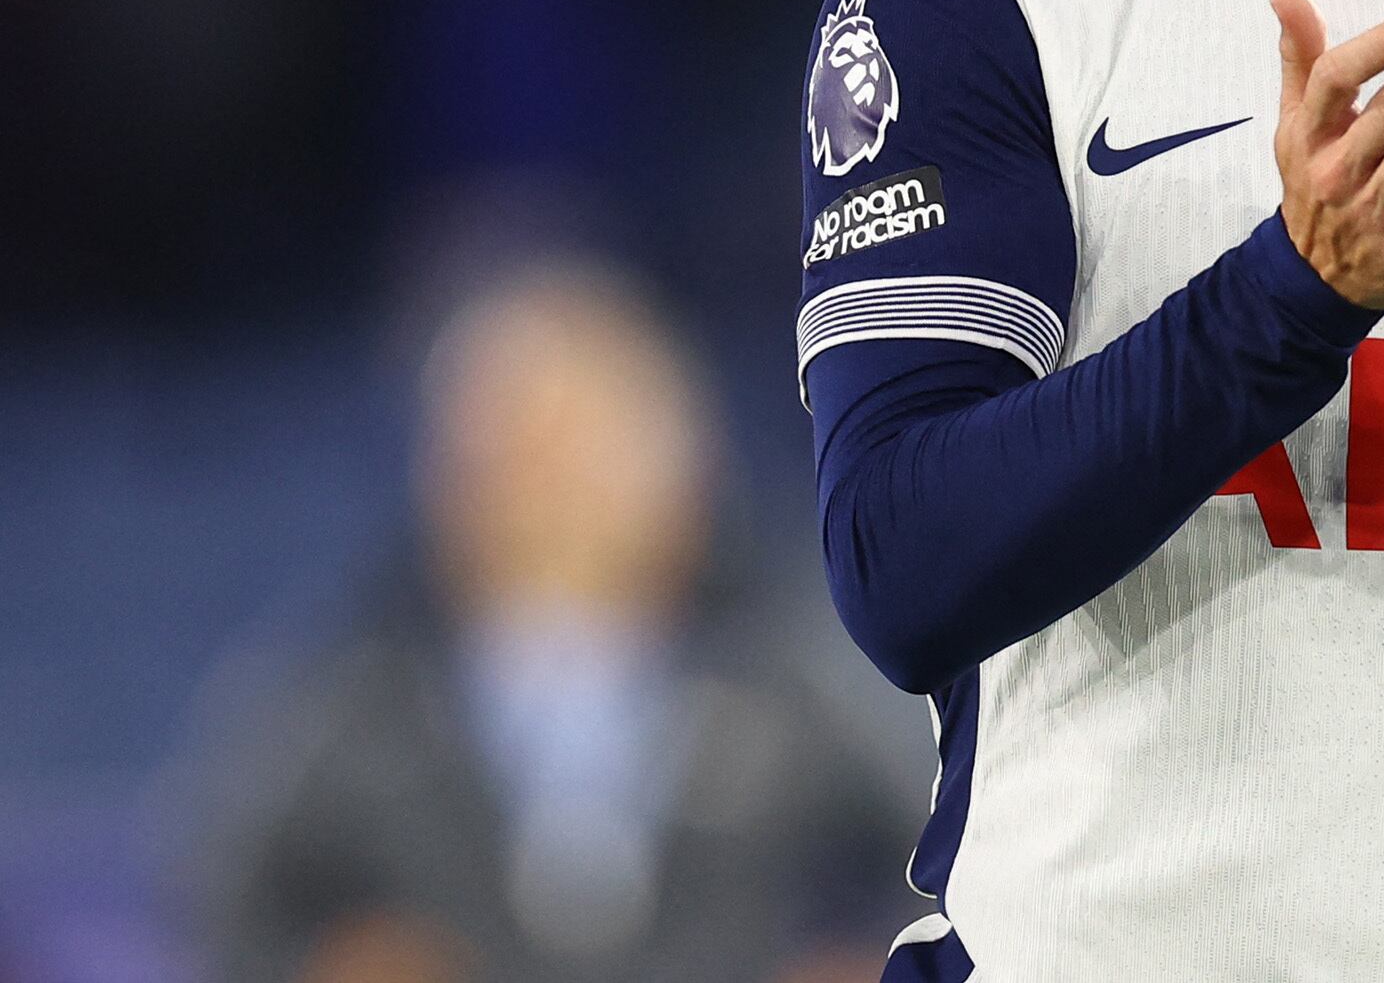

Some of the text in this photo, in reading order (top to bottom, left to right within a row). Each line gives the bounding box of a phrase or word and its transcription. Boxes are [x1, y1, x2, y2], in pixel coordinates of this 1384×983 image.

[811, 179, 925, 248] No room
[841, 203, 945, 255] racism
